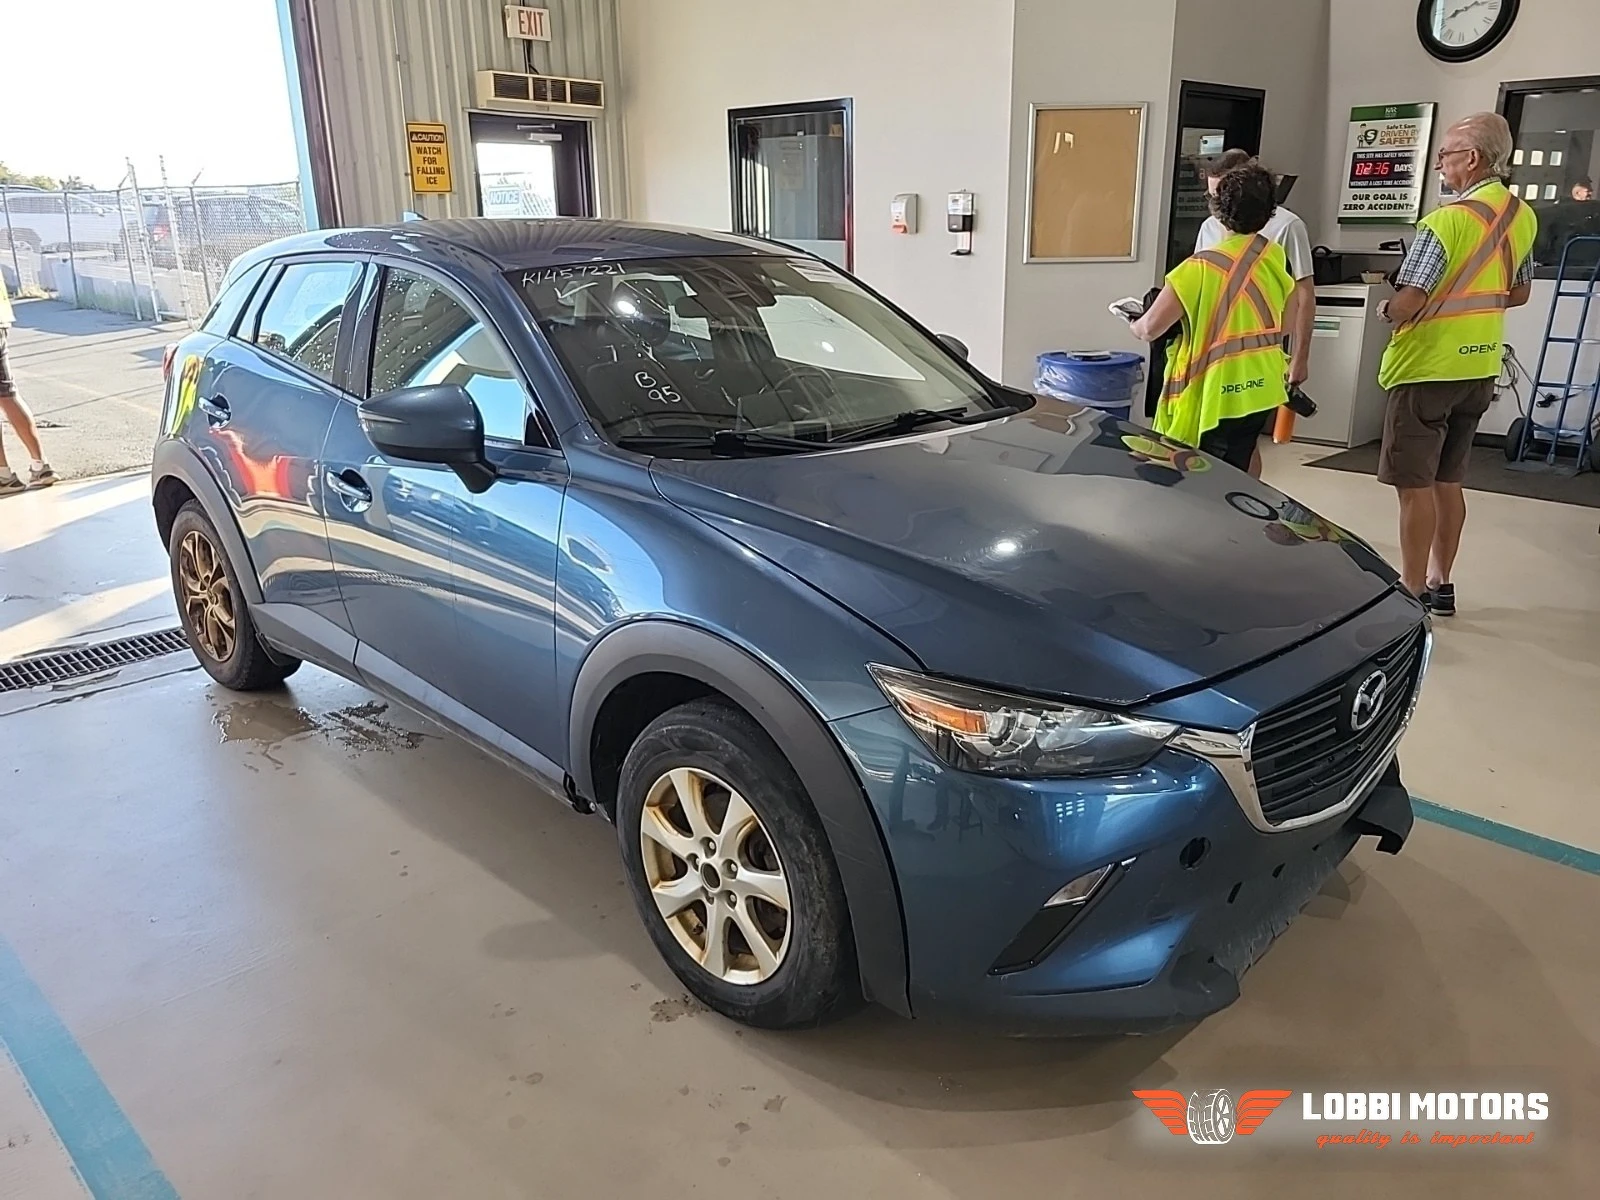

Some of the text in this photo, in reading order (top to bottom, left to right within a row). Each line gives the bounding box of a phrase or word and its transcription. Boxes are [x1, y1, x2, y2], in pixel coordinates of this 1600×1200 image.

[518, 9, 544, 37] EXIT
[417, 133, 444, 142] CAUTION
[1380, 129, 1409, 138] DRIVEN
[1379, 136, 1420, 146] SAFETY
[416, 146, 442, 155] WATCH
[423, 156, 438, 165] FOR
[416, 166, 446, 175] FALLING
[1393, 163, 1413, 172] DAYS
[425, 176, 438, 185] ICE
[489, 190, 520, 205] NOTICE
[1352, 193, 1371, 201] OUR
[1372, 193, 1397, 201] GOAL
[1342, 203, 1365, 211] ZERO
